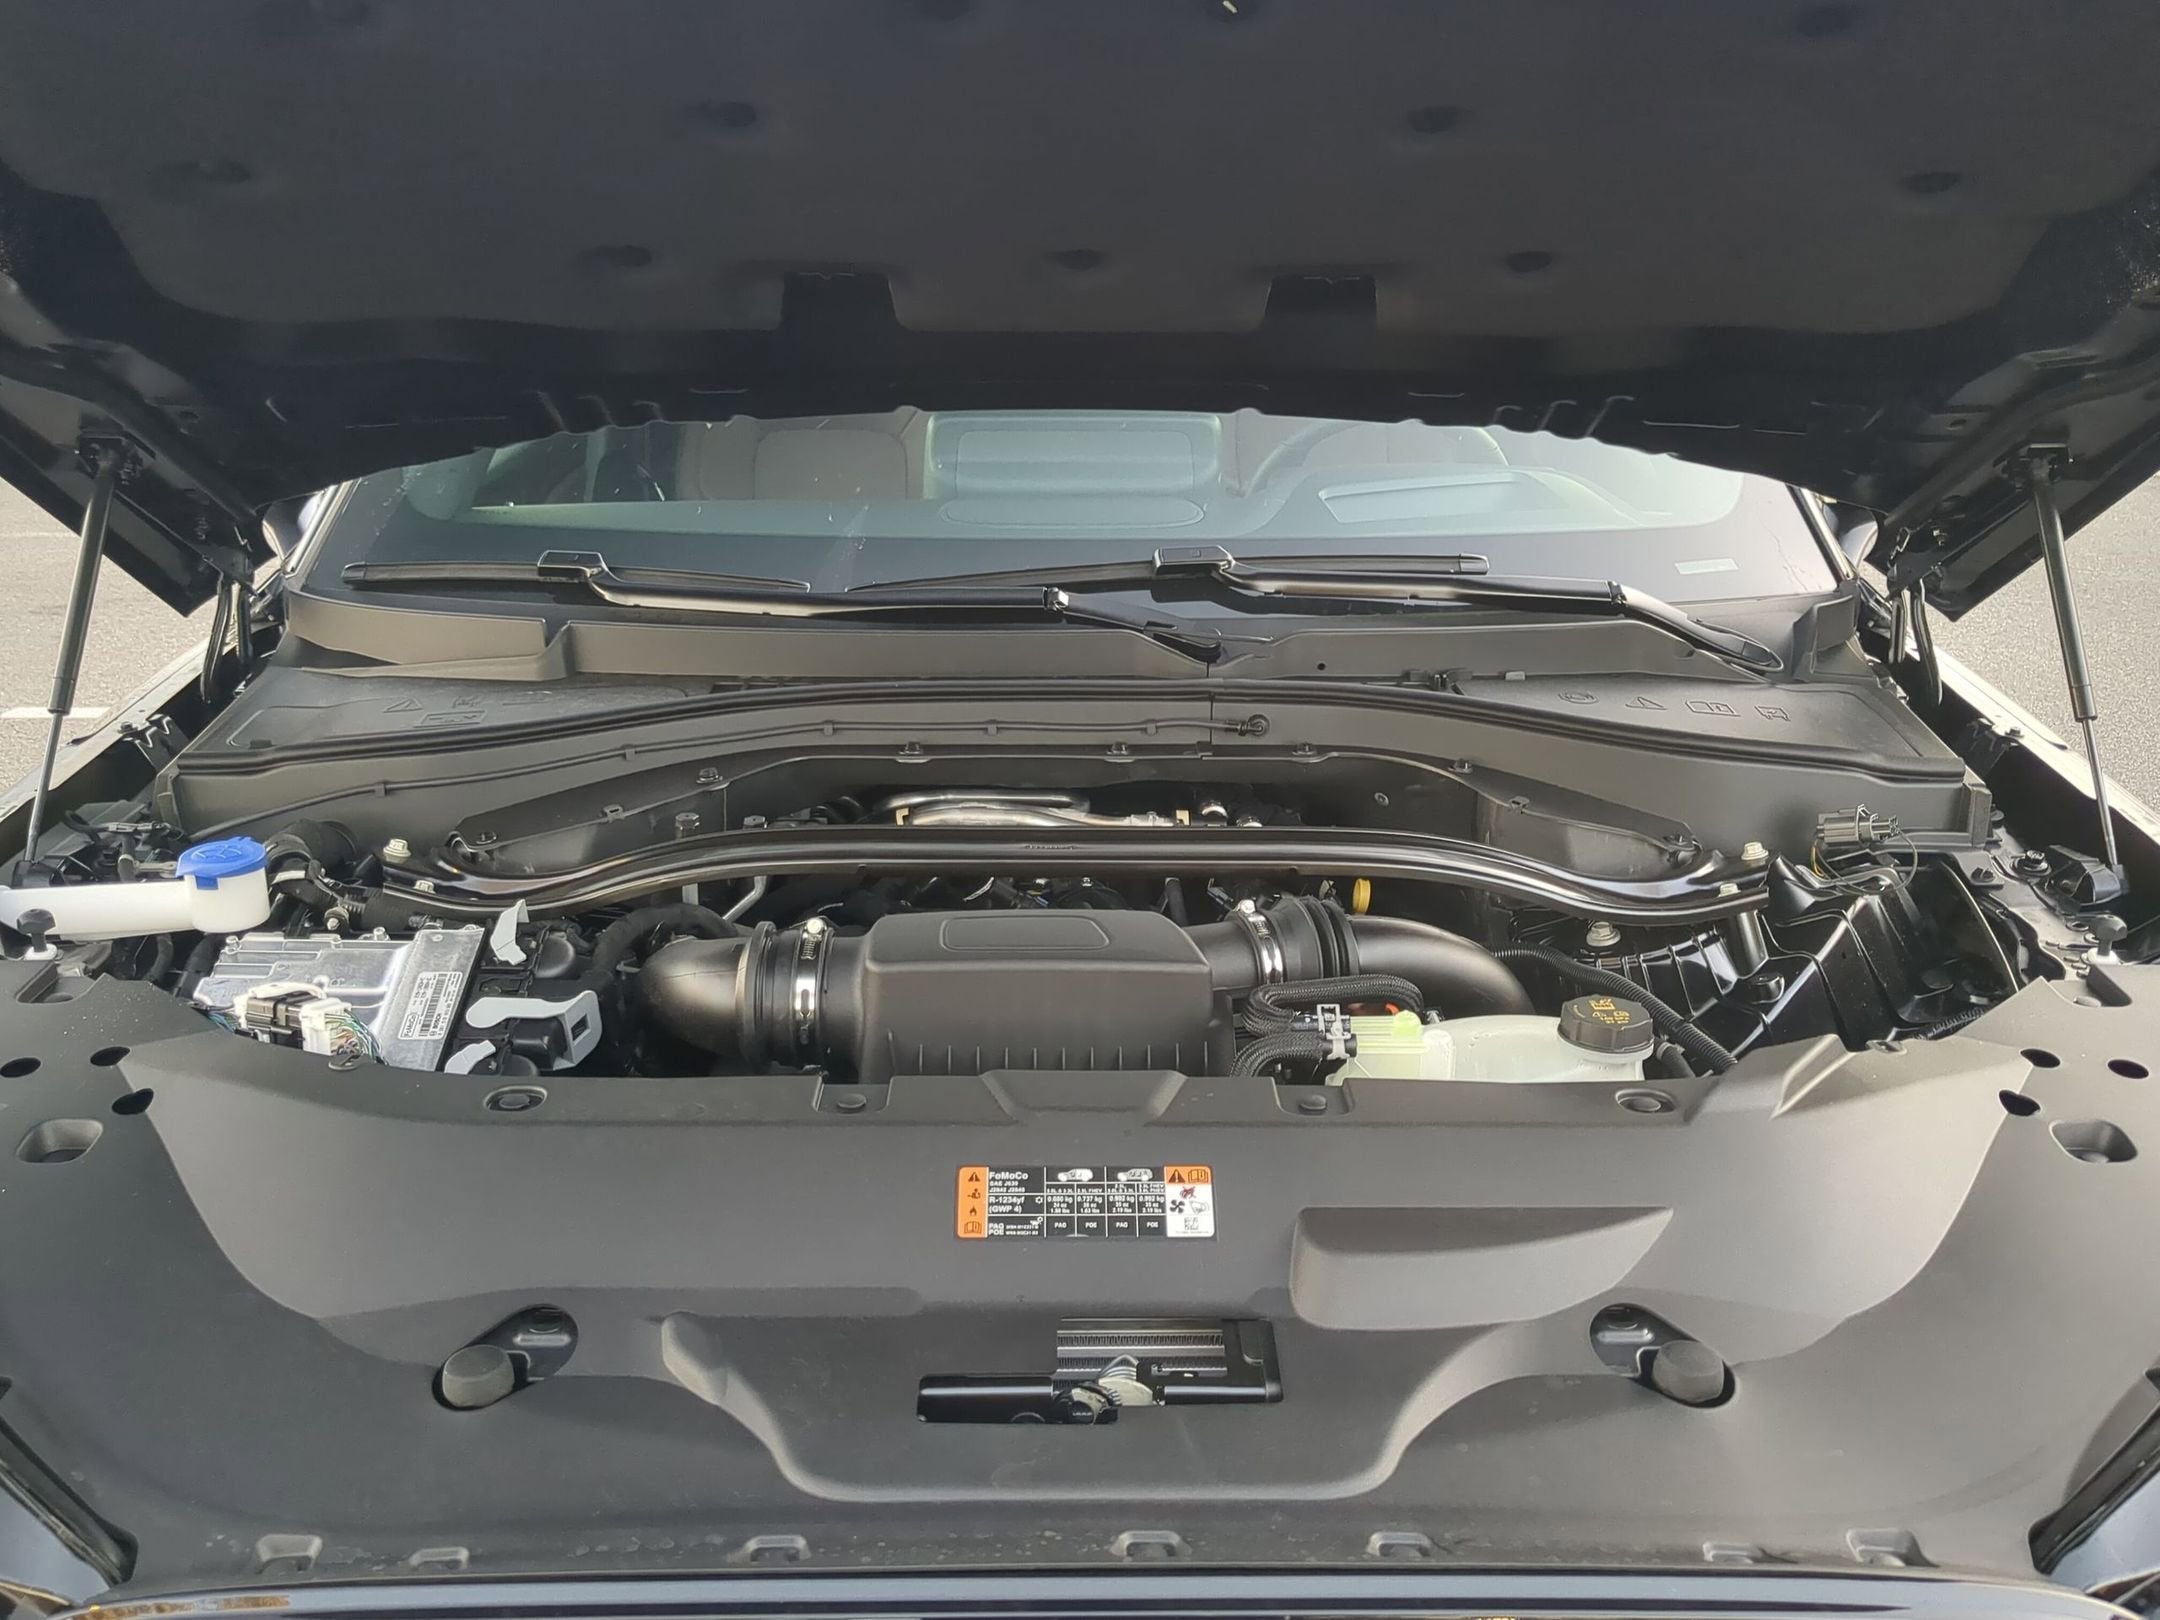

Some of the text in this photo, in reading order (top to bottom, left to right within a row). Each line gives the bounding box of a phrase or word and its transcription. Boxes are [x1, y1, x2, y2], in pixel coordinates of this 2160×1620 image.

[989, 1171, 1029, 1180] FoMoCo
[989, 1196, 1025, 1205] R-1234yf
[989, 1205, 1022, 1214] (GWP 4)
